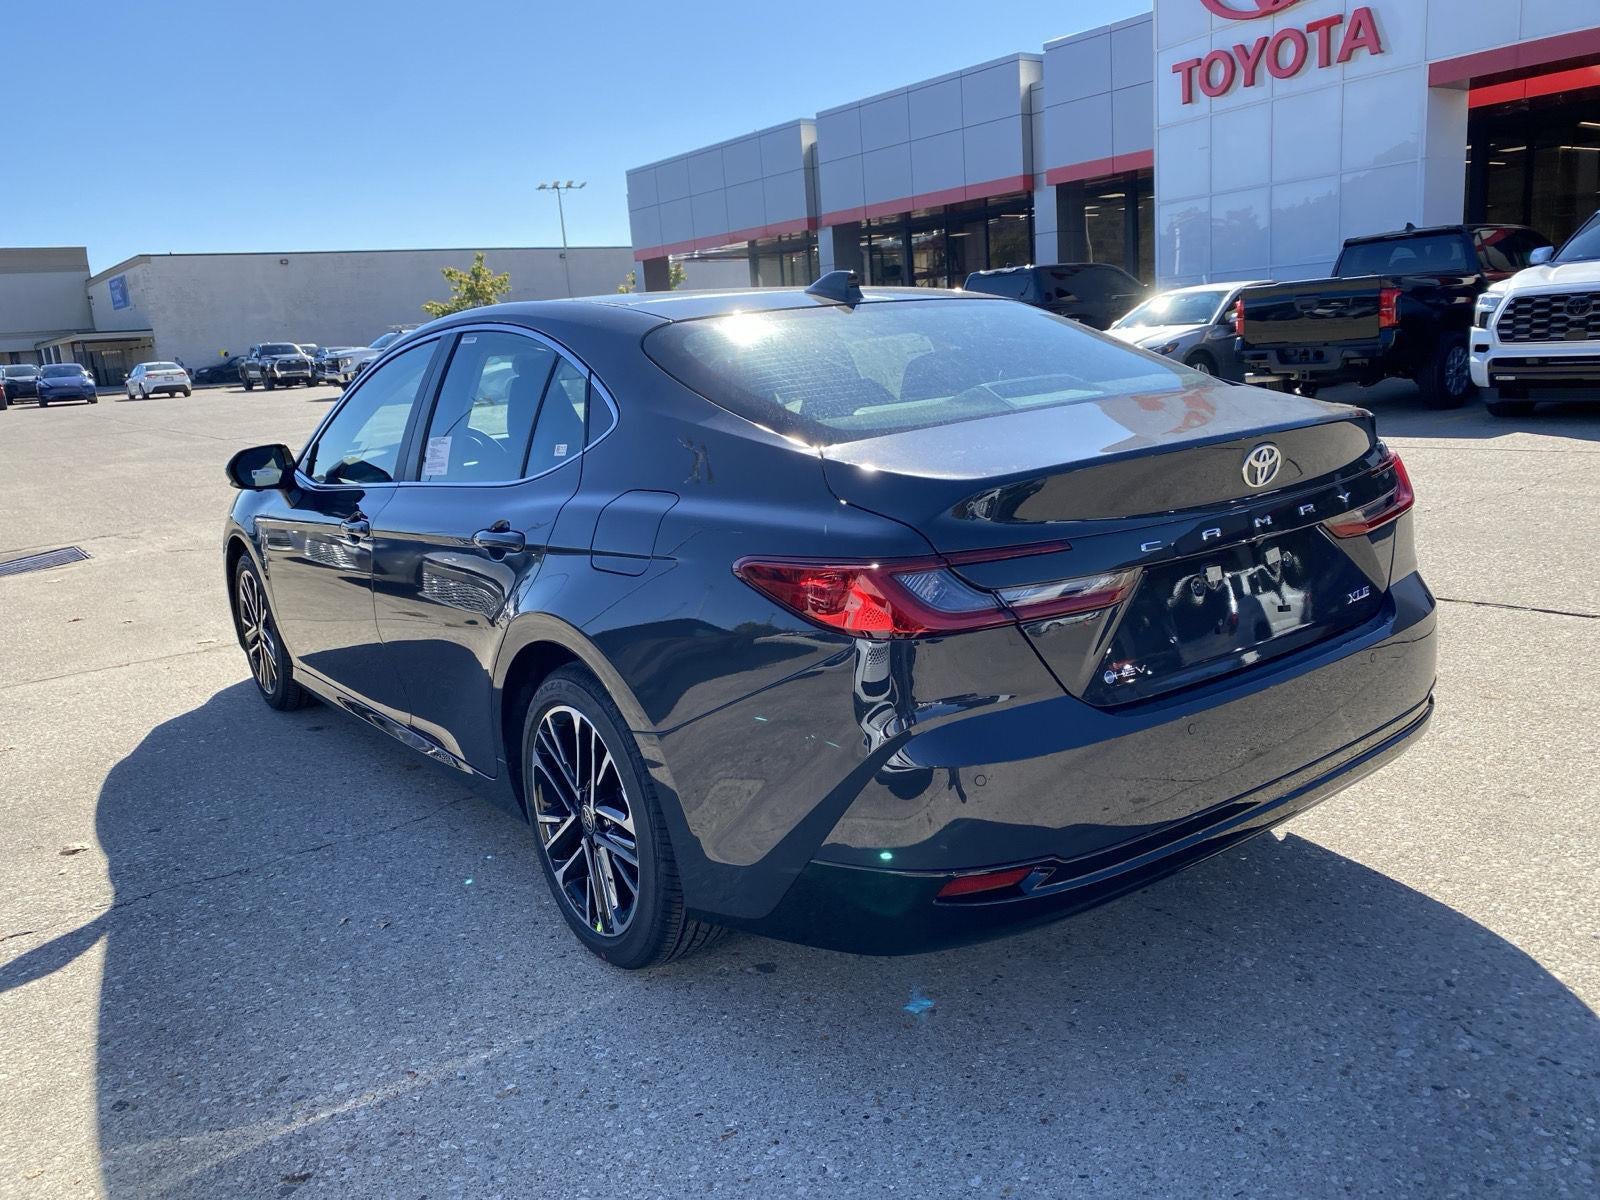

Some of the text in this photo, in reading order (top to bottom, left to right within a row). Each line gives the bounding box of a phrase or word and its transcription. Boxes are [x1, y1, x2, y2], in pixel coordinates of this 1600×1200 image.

[1171, 6, 1384, 105] TOYOTA
[1140, 492, 1351, 552] CAMRY
[1346, 585, 1371, 605] XLE
